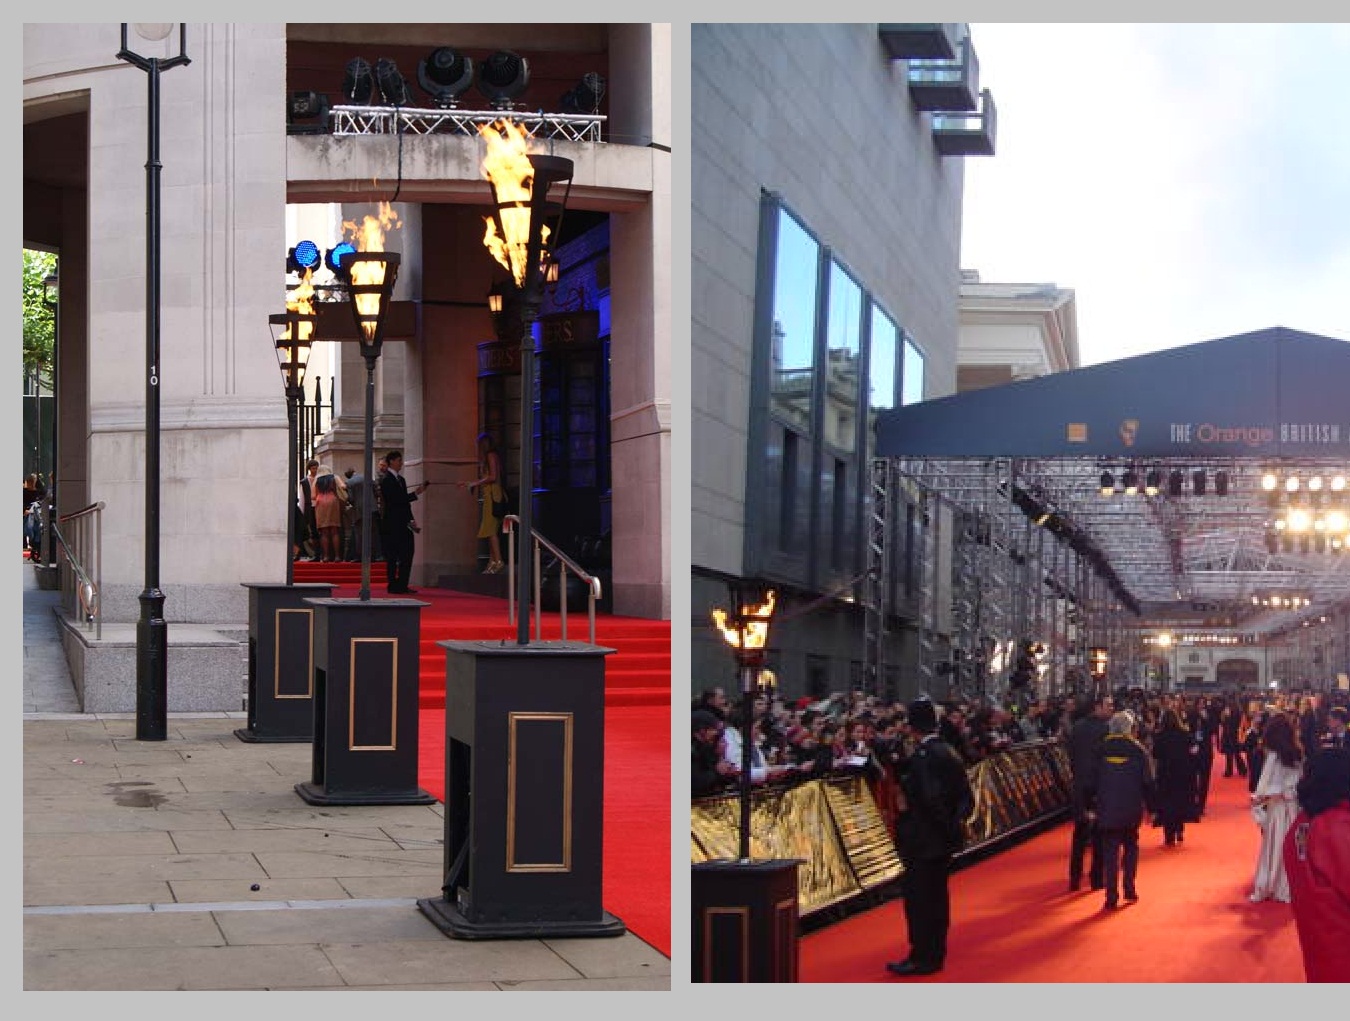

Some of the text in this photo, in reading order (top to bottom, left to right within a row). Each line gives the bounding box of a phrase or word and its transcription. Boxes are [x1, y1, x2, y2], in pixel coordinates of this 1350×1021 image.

[1170, 424, 1192, 443] THE
[1197, 423, 1274, 447] Orange
[1280, 424, 1341, 443] BRITISH
